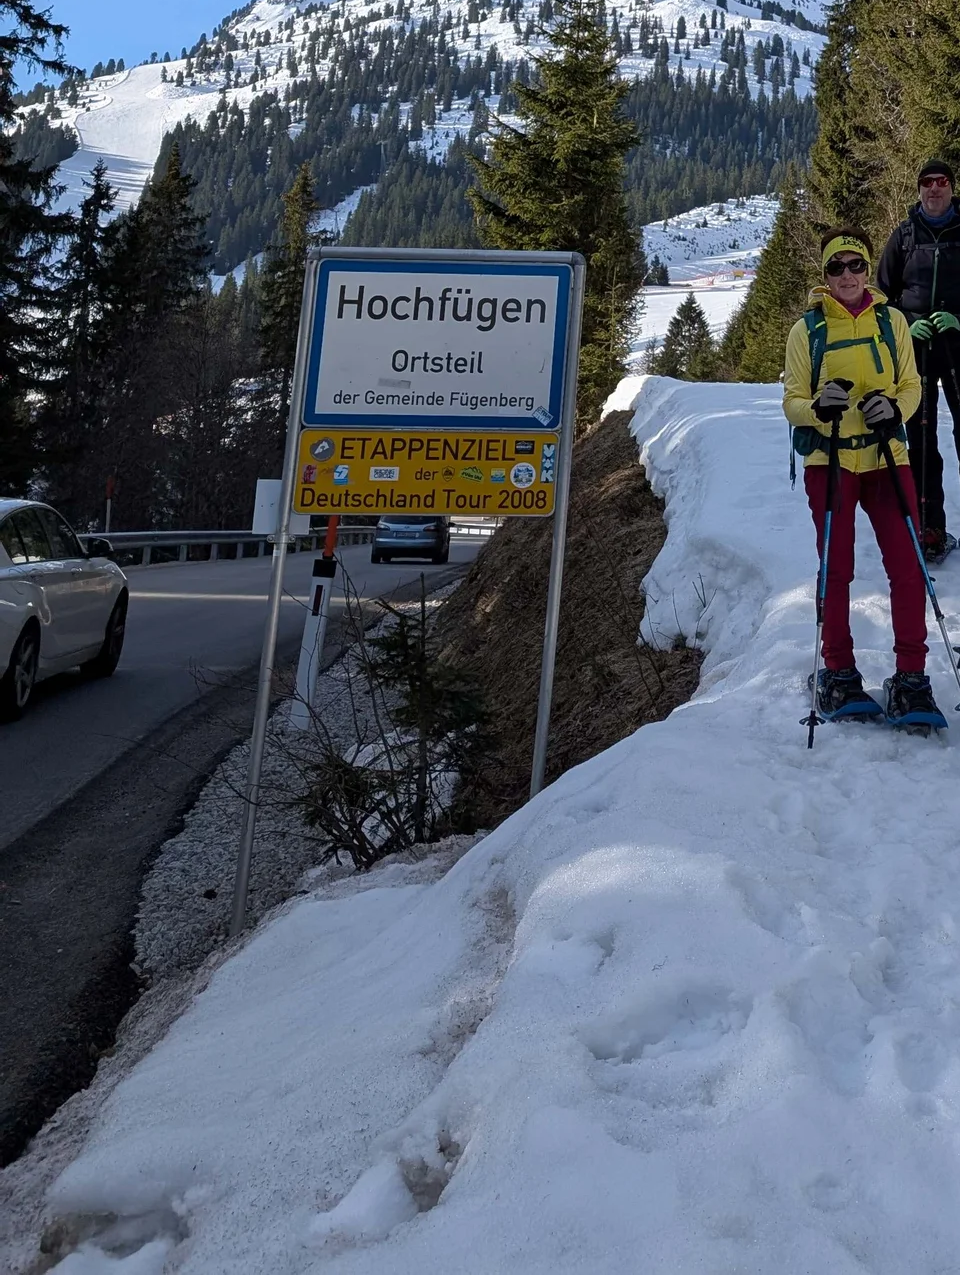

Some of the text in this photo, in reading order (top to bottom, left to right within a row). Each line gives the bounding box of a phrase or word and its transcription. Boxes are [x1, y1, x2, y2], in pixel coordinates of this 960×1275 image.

[337, 284, 547, 332] Hochfügen
[391, 349, 483, 374] Ortsteil
[333, 390, 535, 411] der Gemeinde Fügenberg
[340, 437, 516, 462] ETAPPENZIEL
[414, 467, 439, 481] der
[300, 487, 548, 510] Deutschland Tour 2008
